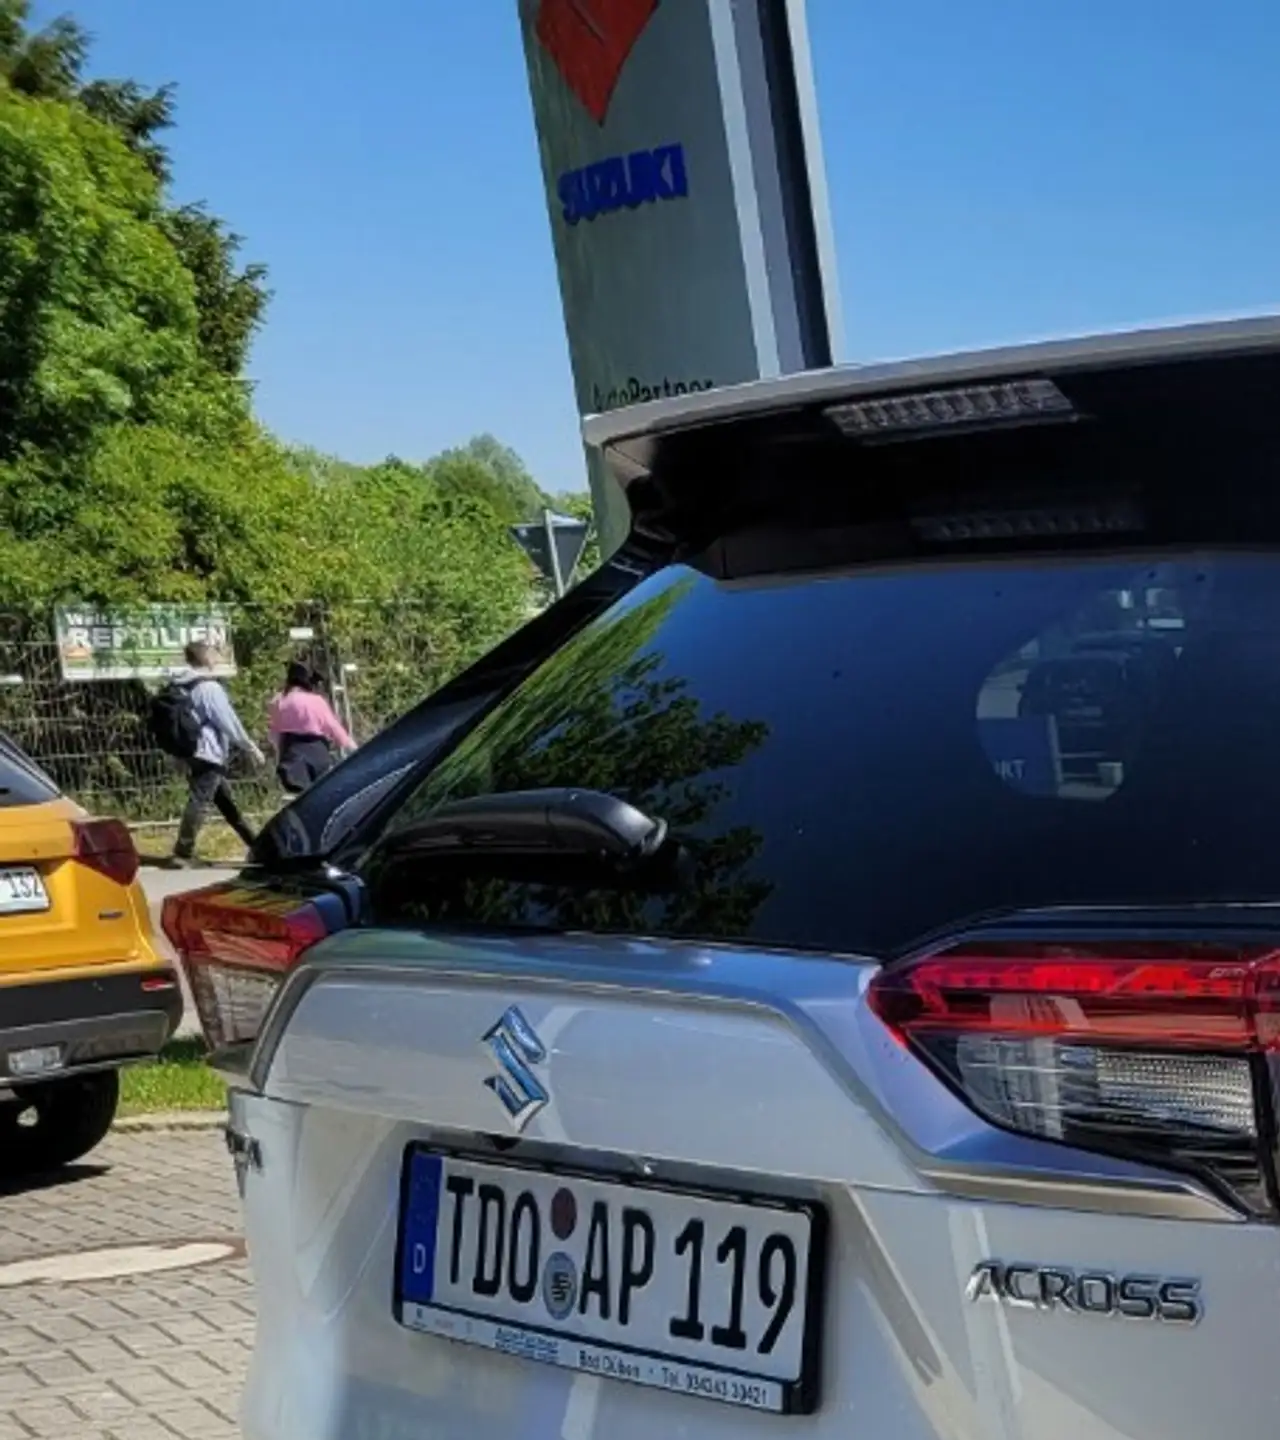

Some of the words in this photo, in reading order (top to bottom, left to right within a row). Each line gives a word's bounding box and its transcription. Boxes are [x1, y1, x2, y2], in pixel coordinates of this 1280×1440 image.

[557, 142, 689, 226] SUZUKI
[413, 1247, 426, 1275] D
[446, 1175, 542, 1304] TDO
[579, 1200, 656, 1326] AP
[669, 1218, 798, 1355] 119
[966, 1258, 1204, 1327] ACROSS
